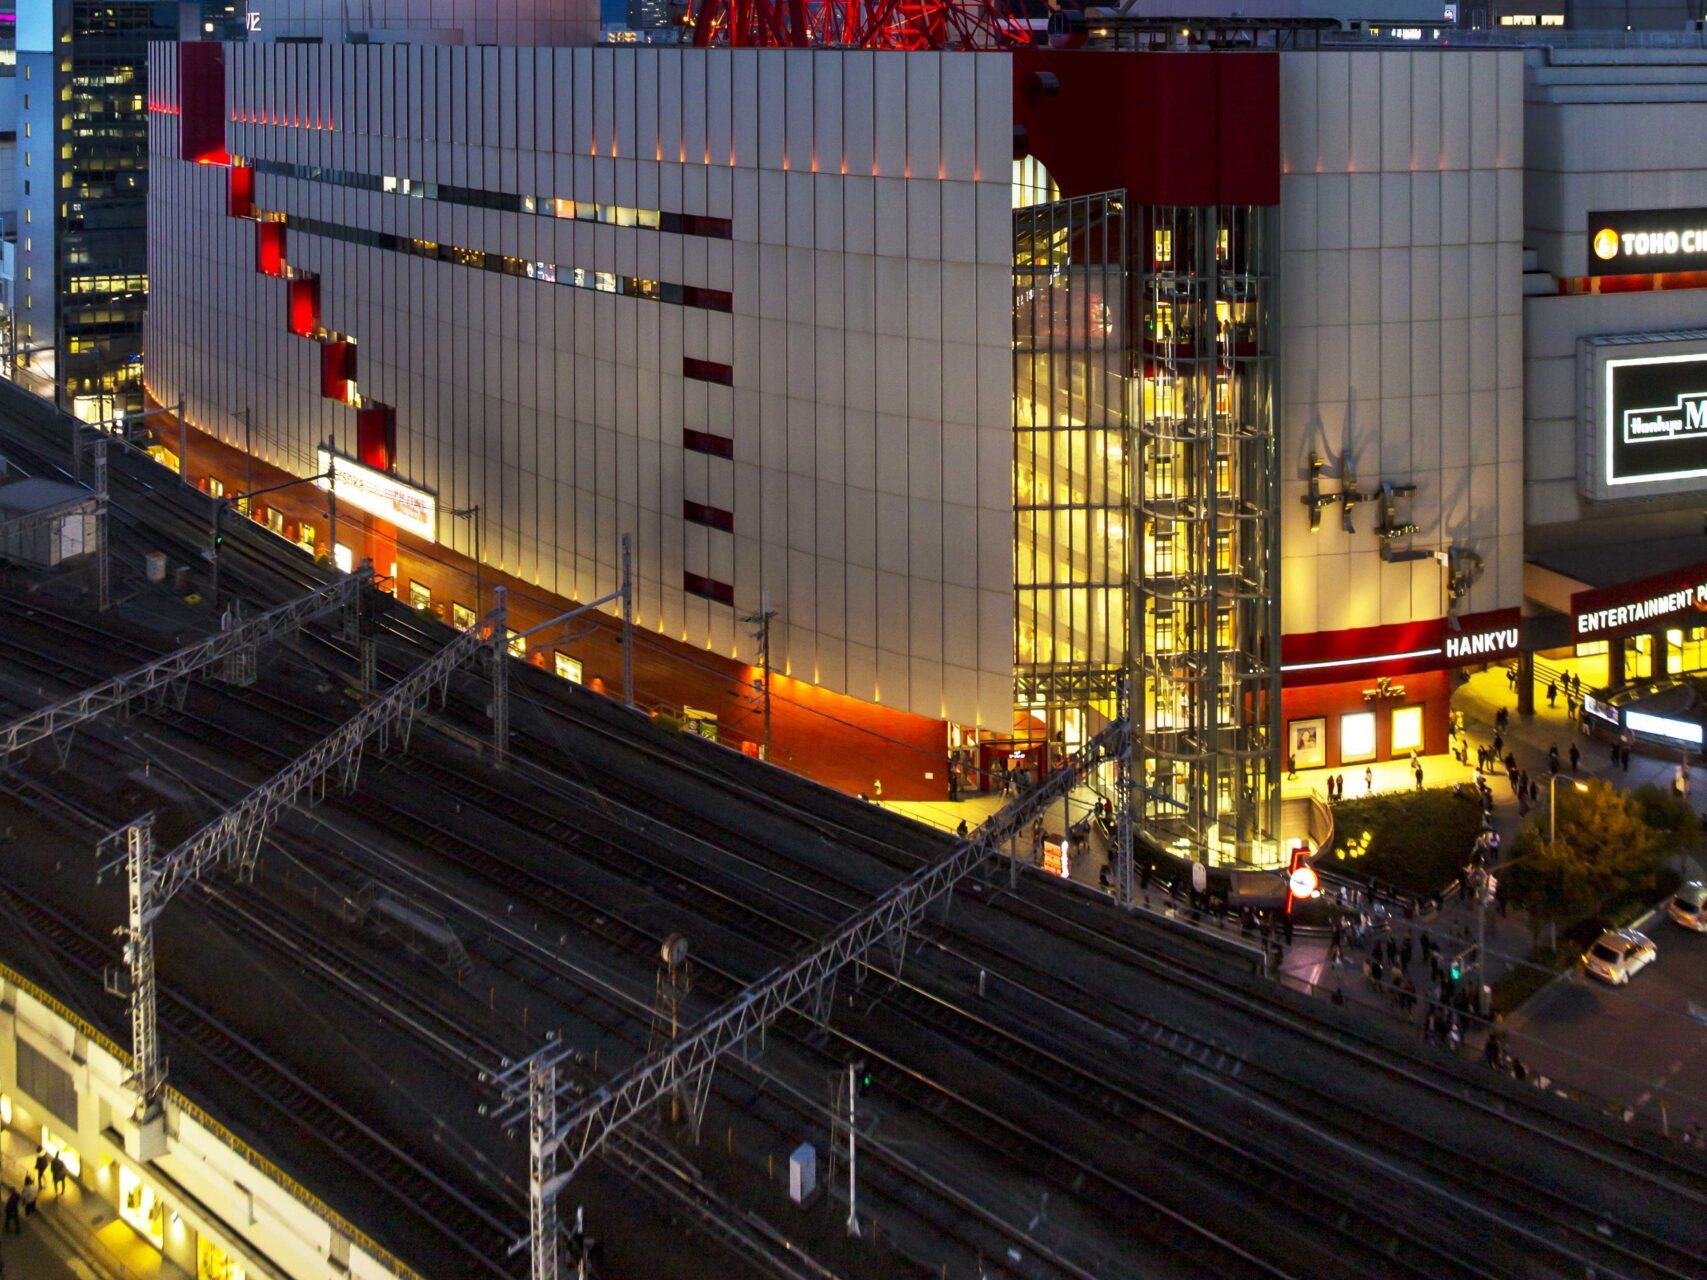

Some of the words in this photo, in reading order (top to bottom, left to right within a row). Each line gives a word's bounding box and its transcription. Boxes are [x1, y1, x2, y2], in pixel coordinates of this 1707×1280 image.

[1621, 231, 1679, 256] TOHO
[1578, 588, 1694, 634] ENTERTAINMENT
[1446, 628, 1518, 658] HANKYU
